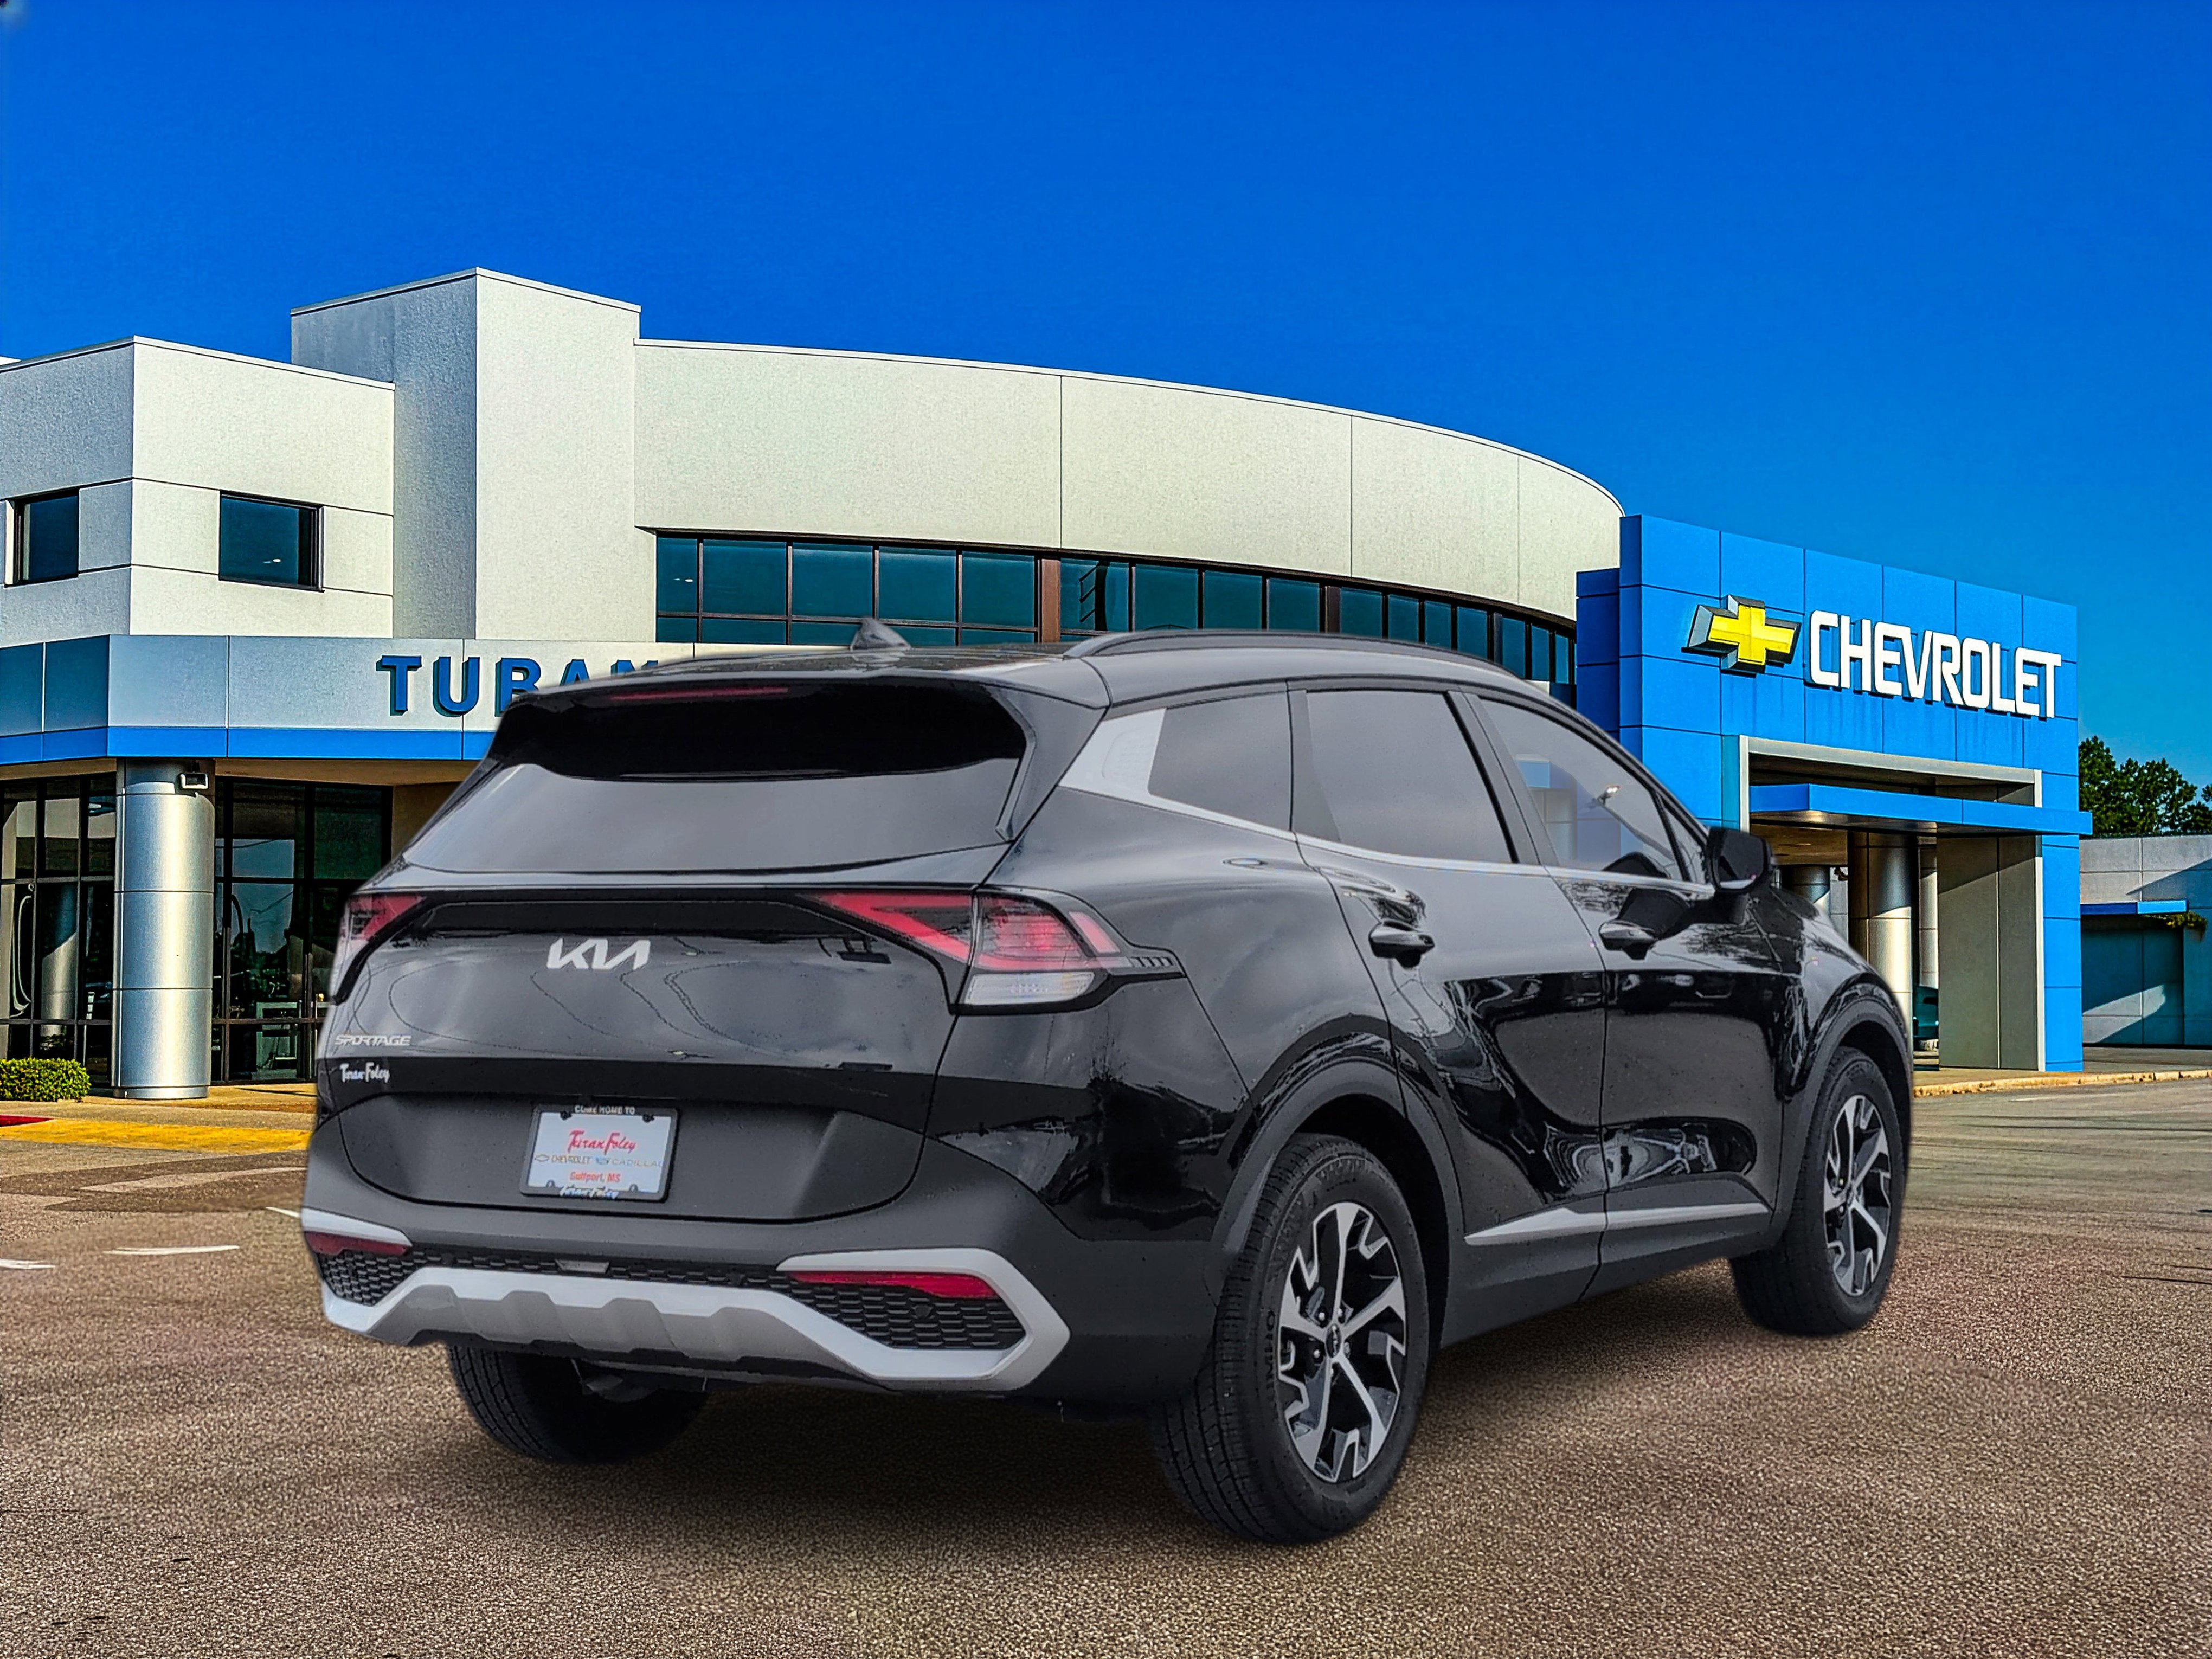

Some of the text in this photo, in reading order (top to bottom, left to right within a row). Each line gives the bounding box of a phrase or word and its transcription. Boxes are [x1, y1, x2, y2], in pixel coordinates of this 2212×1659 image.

[1810, 610, 2062, 718] CHEVROLET
[377, 655, 658, 716] TUR
[335, 1034, 412, 1047] SPORTAGE
[624, 1106, 636, 1115] TO
[607, 1173, 621, 1182] MS
